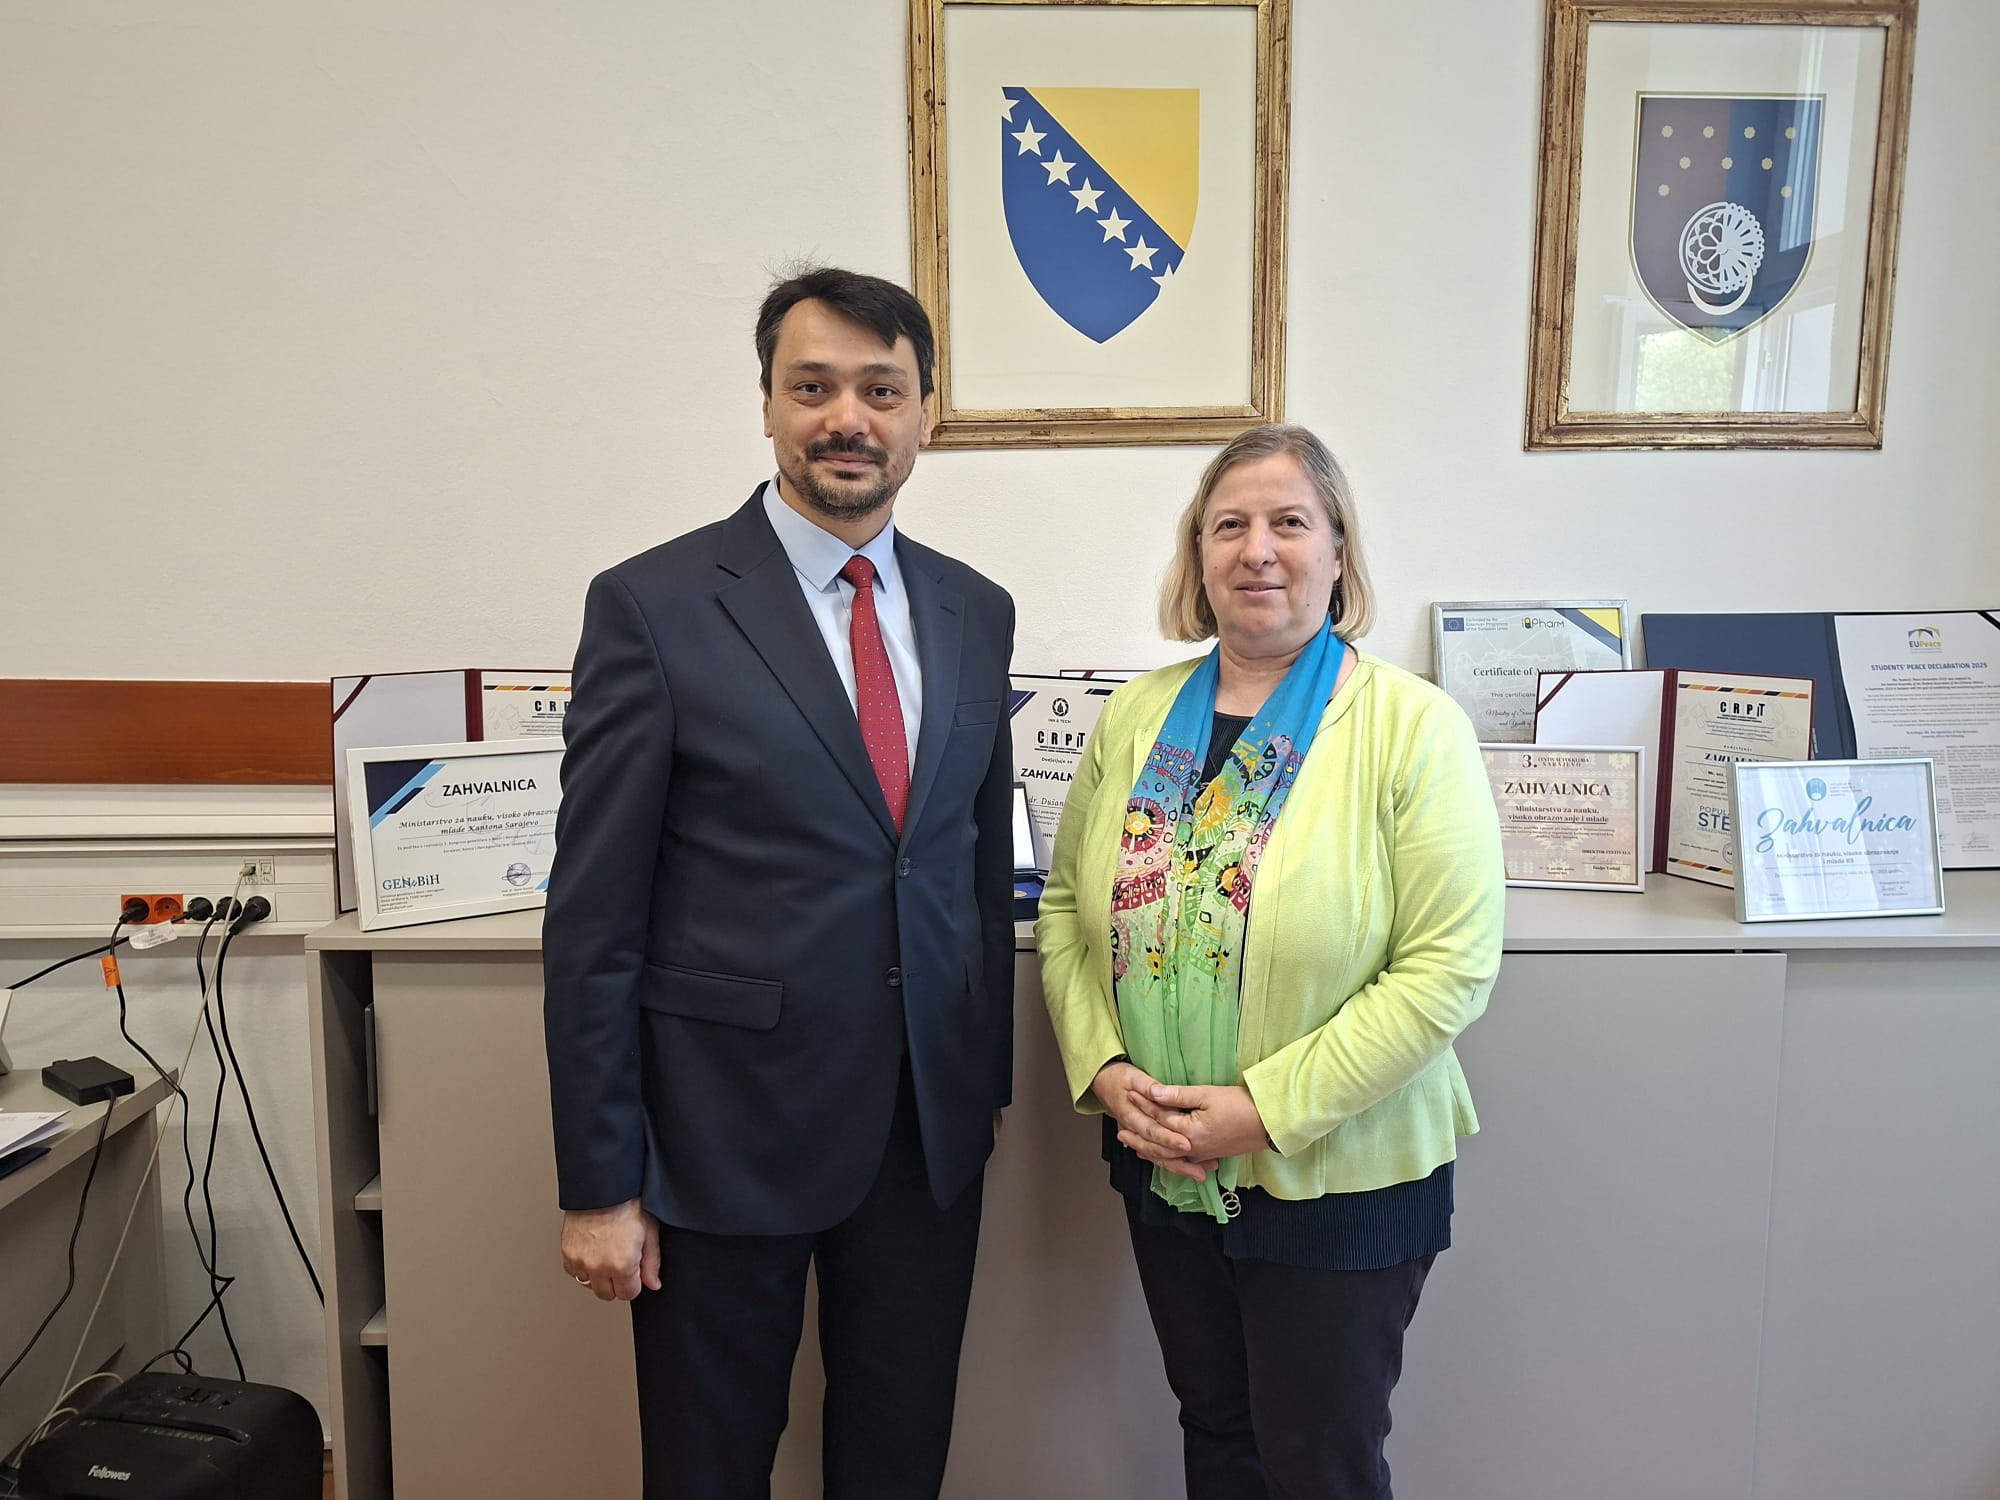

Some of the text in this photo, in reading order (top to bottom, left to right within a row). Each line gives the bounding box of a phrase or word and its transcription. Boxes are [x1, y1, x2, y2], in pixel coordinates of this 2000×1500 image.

[1473, 668, 1521, 677] Certificate
[1524, 667, 1534, 676] of
[1928, 662, 1970, 670] DECLARATION
[1522, 754, 1538, 768] 3.
[443, 778, 537, 797] ZAHVALNICA
[1504, 782, 1610, 796] ZAHVALNICA
[1028, 796, 1039, 804] dr.
[1515, 805, 1562, 813] Ministarstvo
[1699, 805, 1730, 817] POPUL
[399, 817, 453, 829] Ministarstvo
[455, 816, 465, 824] za
[467, 813, 495, 823] nauku,
[497, 810, 521, 820] visoko
[1534, 814, 1581, 823] obrazovanje
[1698, 812, 1731, 831] STE
[1756, 796, 1917, 853] Zahvalnica
[441, 819, 539, 835] mlade Kantona Sarajevo
[88, 1464, 131, 1481] Fellowes
